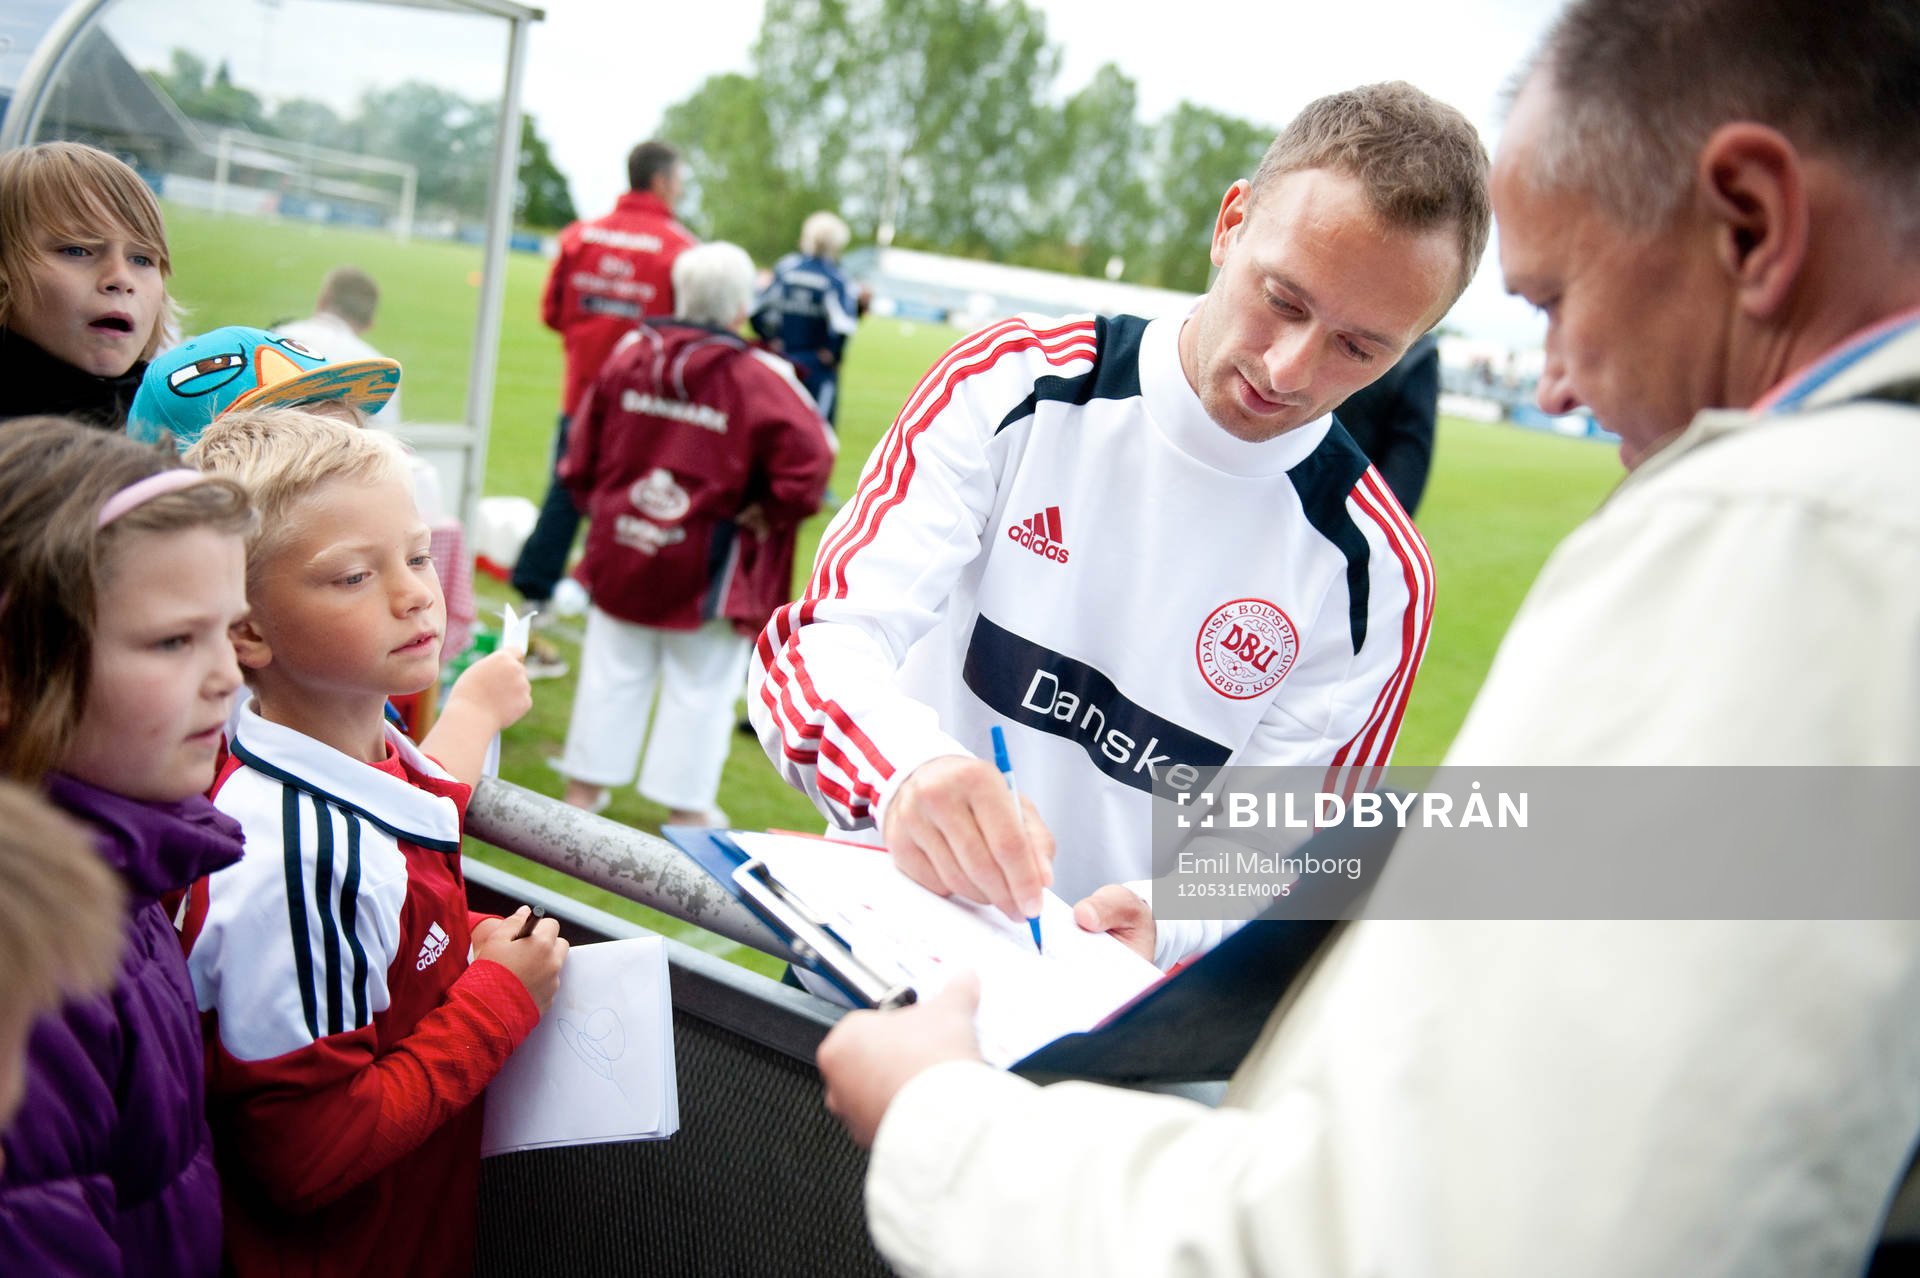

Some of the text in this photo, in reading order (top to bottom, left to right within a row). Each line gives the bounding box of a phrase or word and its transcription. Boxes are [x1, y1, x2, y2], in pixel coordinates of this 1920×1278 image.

[1007, 524, 1070, 564] adidas
[1202, 610, 1233, 663] DANSK
[1220, 623, 1278, 673] DBU
[1209, 669, 1244, 694] 1889
[1020, 668, 1200, 791] Danske
[416, 934, 450, 971] adidas
